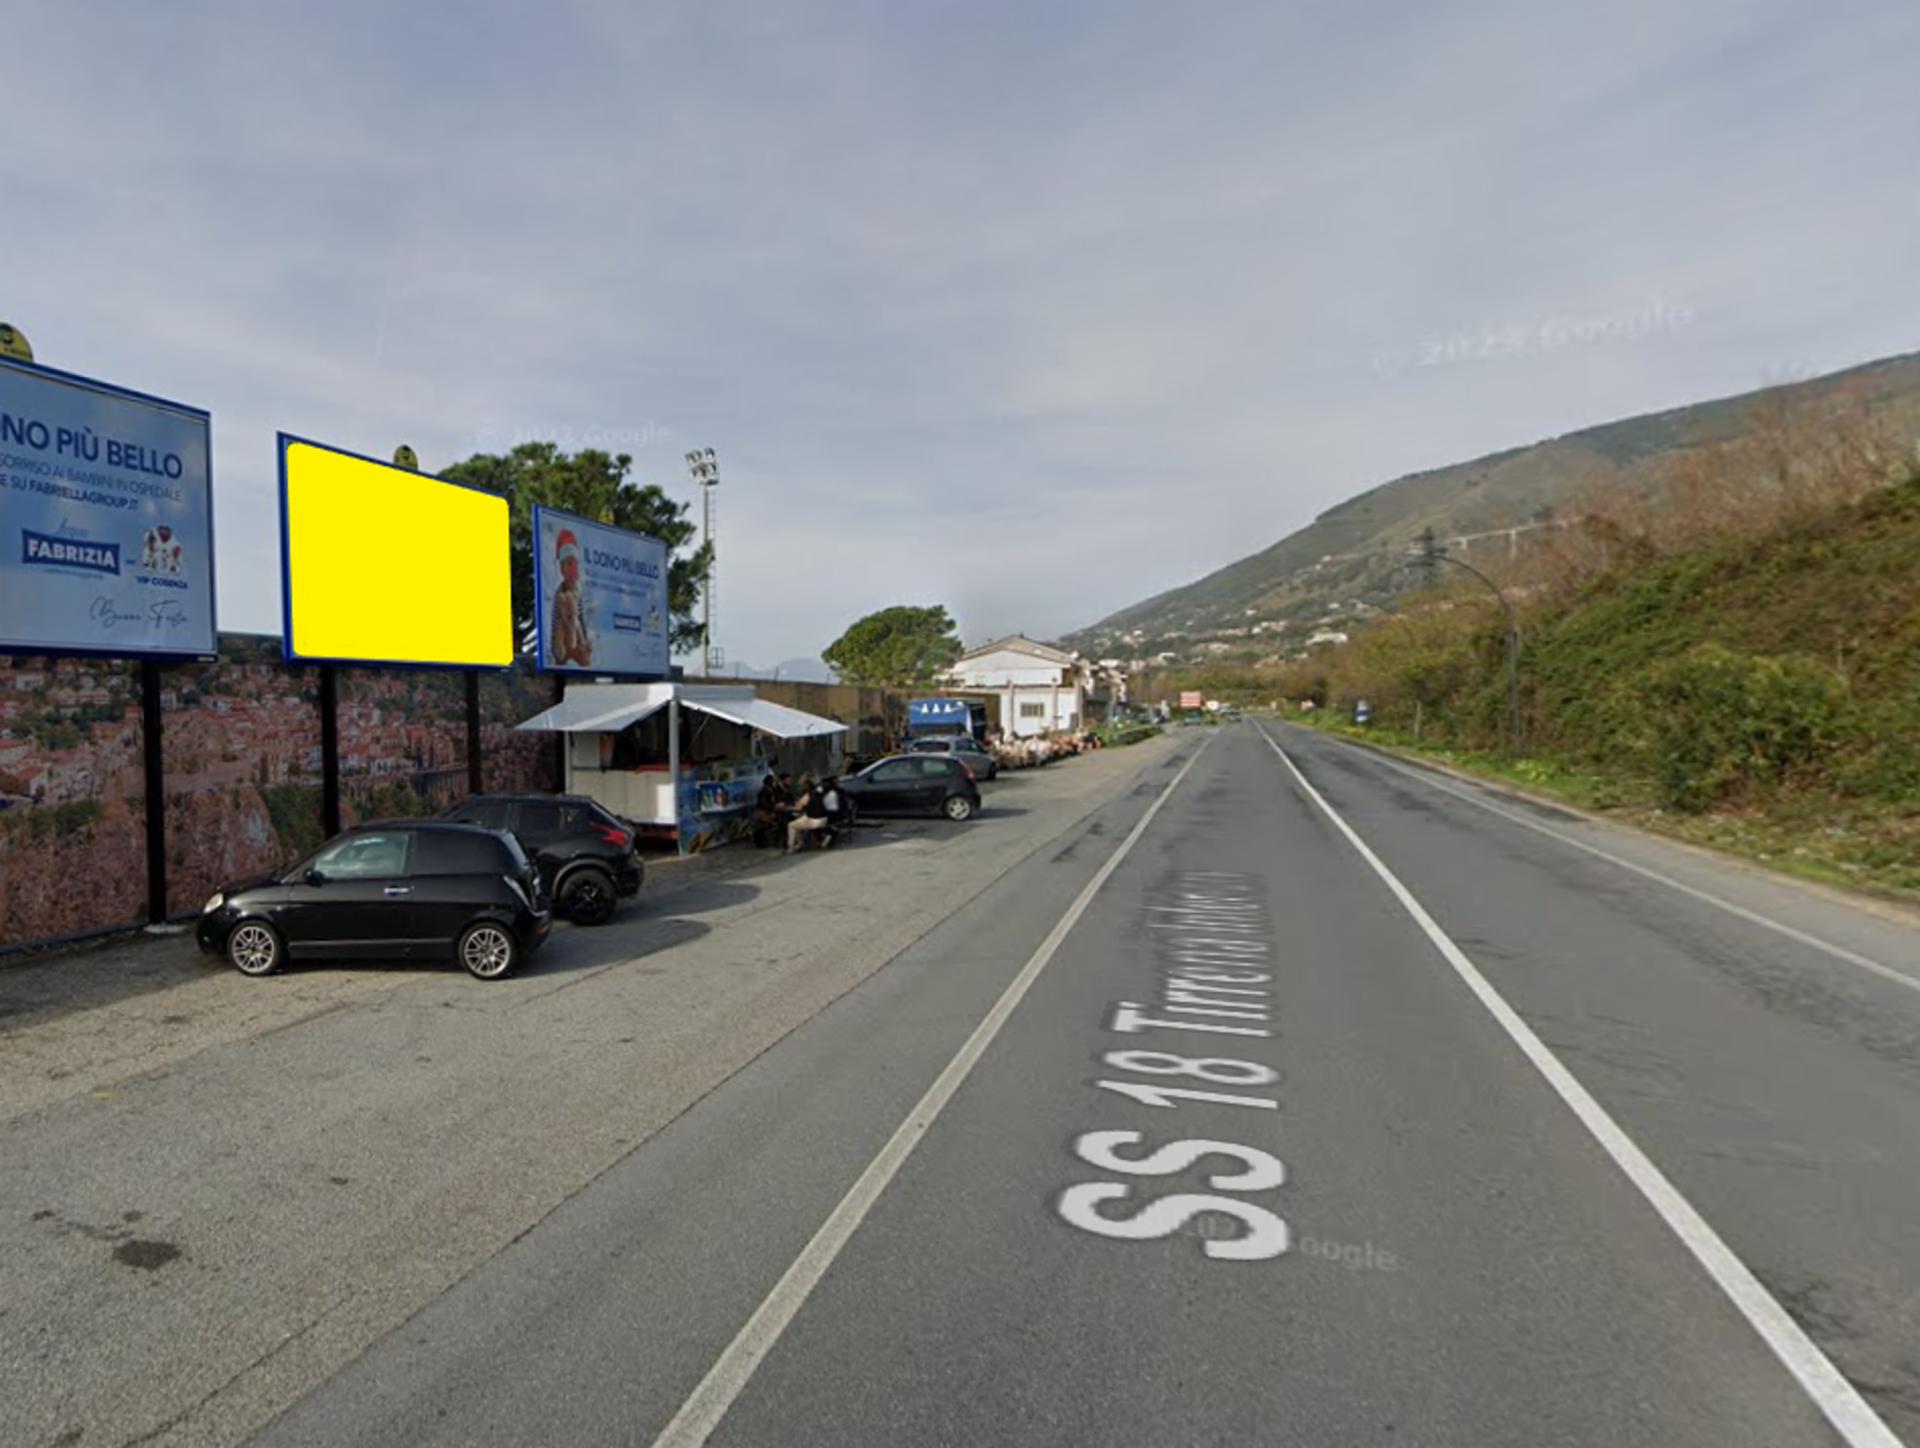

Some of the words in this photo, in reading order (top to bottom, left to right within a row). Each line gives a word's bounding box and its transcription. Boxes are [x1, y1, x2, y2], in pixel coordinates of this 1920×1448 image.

[57, 425, 99, 461] PIÙ
[107, 439, 183, 480] BELLO
[27, 538, 116, 569] FABRIZIA
